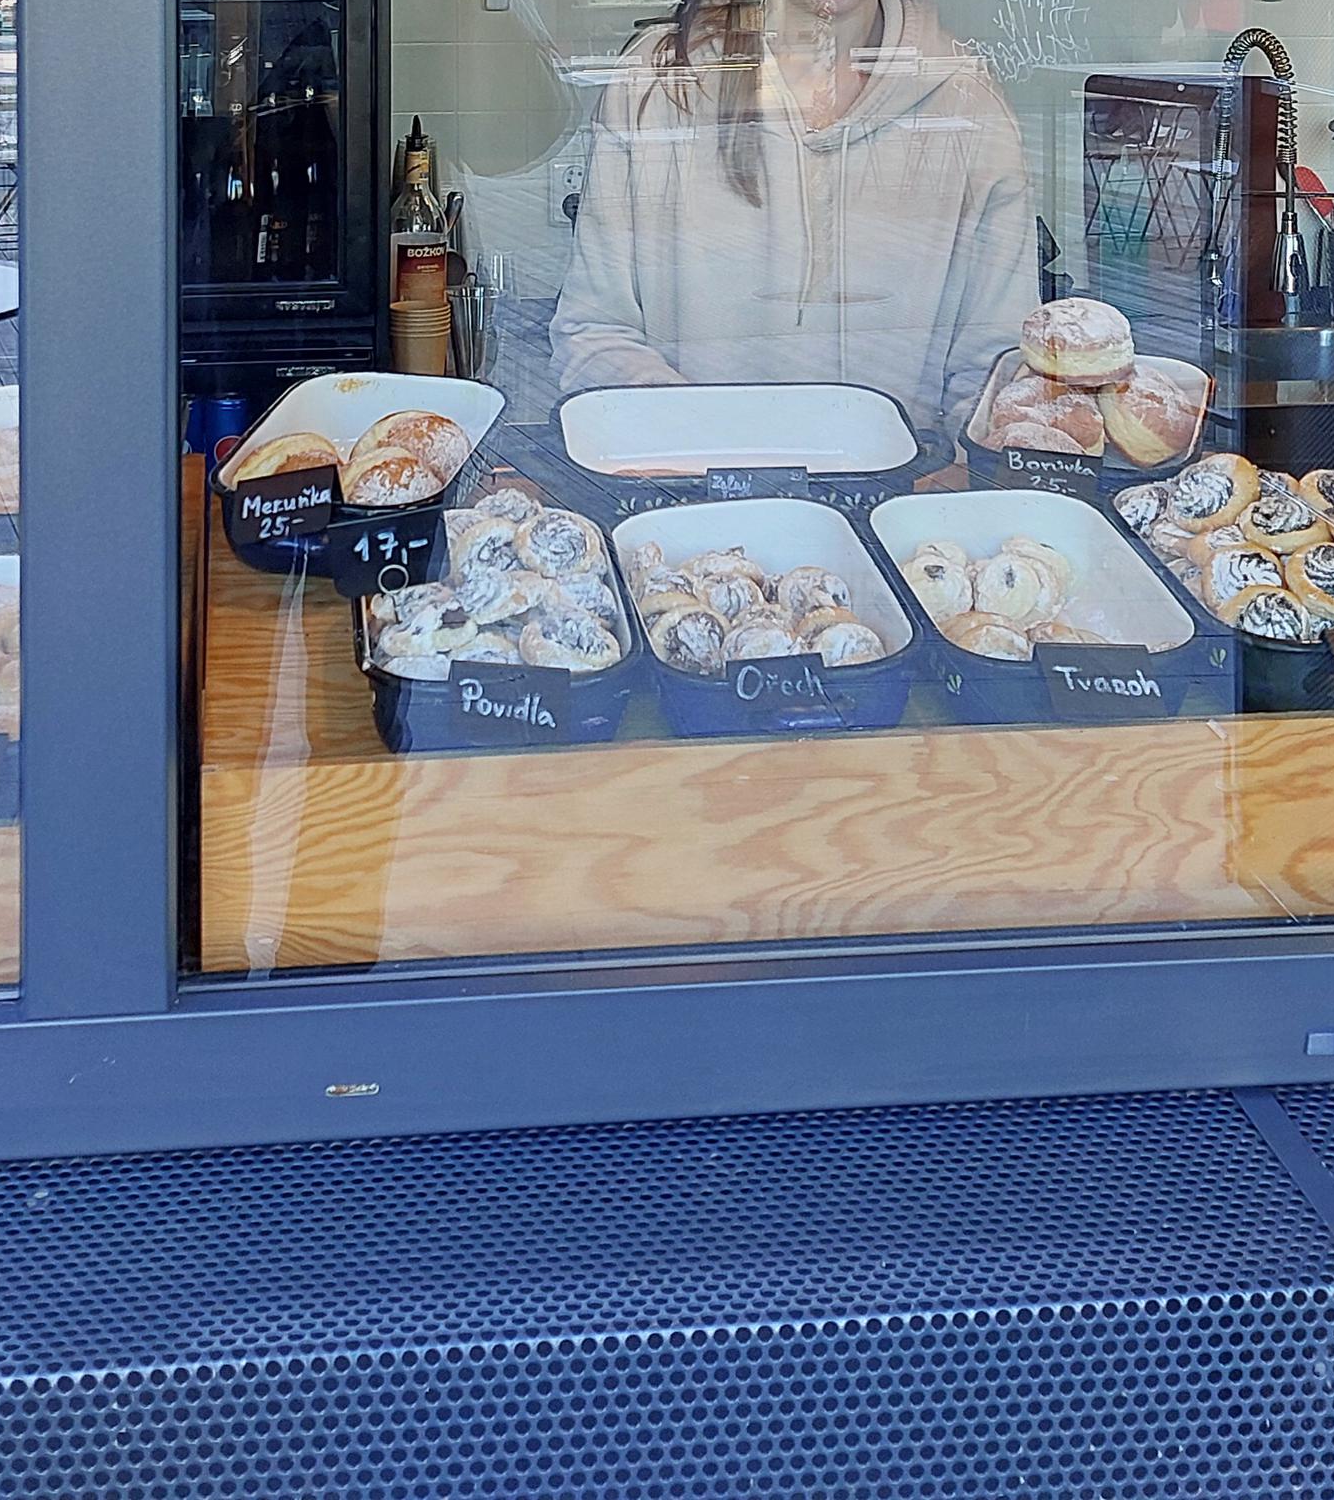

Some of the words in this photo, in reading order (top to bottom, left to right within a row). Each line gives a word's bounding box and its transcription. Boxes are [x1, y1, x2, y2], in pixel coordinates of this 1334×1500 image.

[241, 484, 333, 520] Meruňka
[736, 665, 827, 700] Ořech
[1051, 665, 1162, 698] Tvaroh
[458, 678, 557, 729] Povidla
